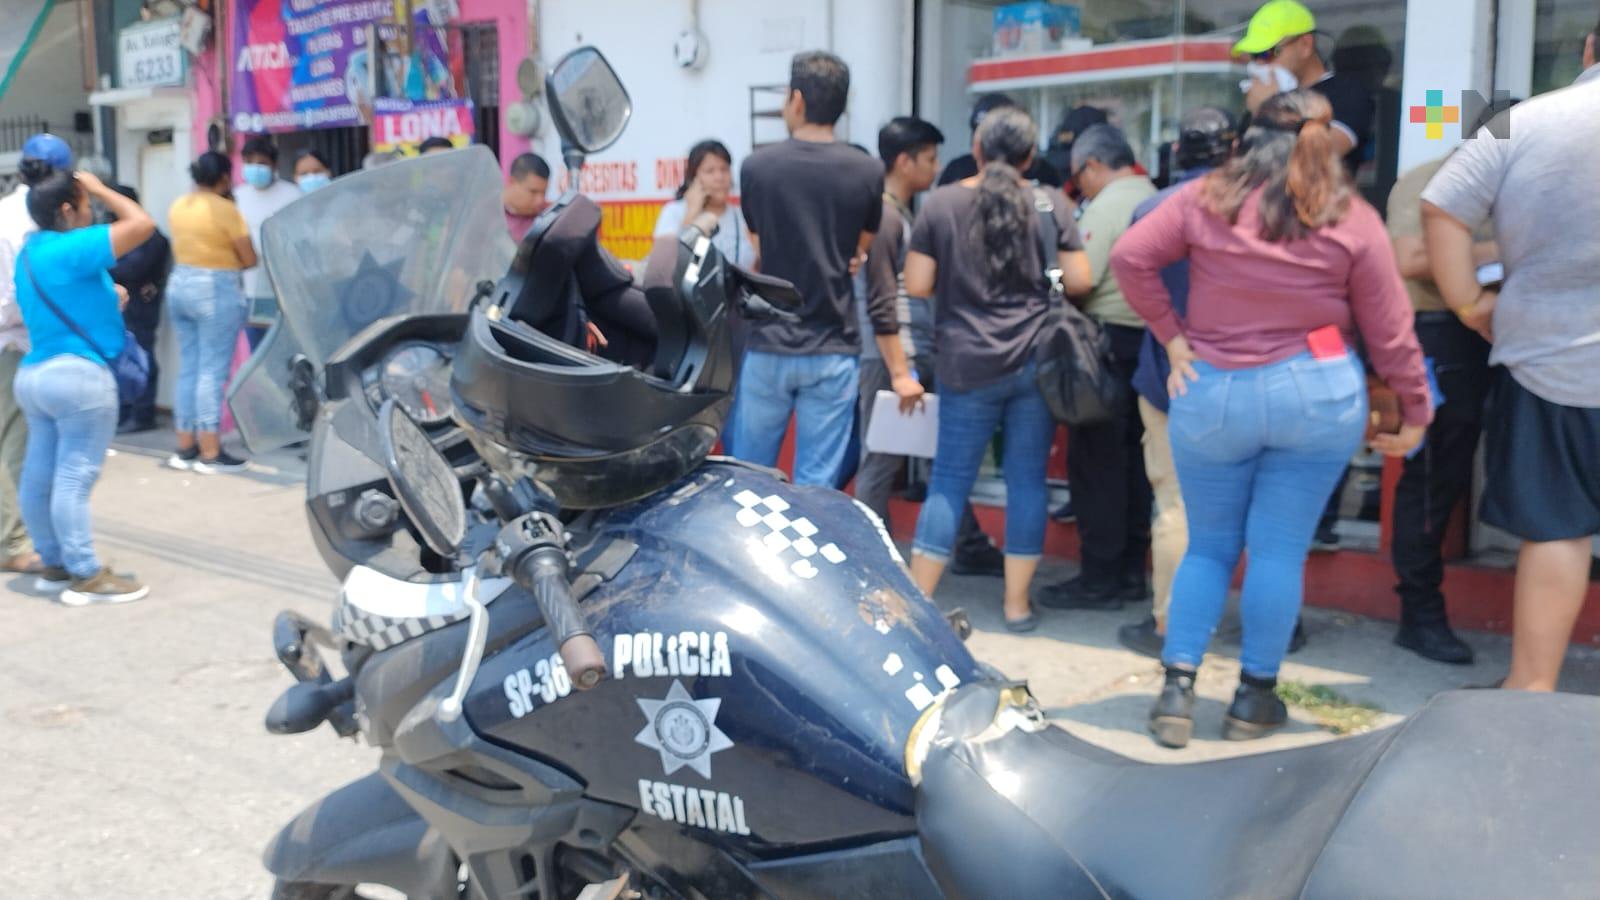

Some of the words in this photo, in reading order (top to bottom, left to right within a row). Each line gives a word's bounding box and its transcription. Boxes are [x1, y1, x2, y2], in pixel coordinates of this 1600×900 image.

[135, 54, 174, 83] 6233
[383, 107, 461, 145] LONA
[613, 631, 732, 679] POLICIA
[638, 779, 750, 835] ESTATAL
